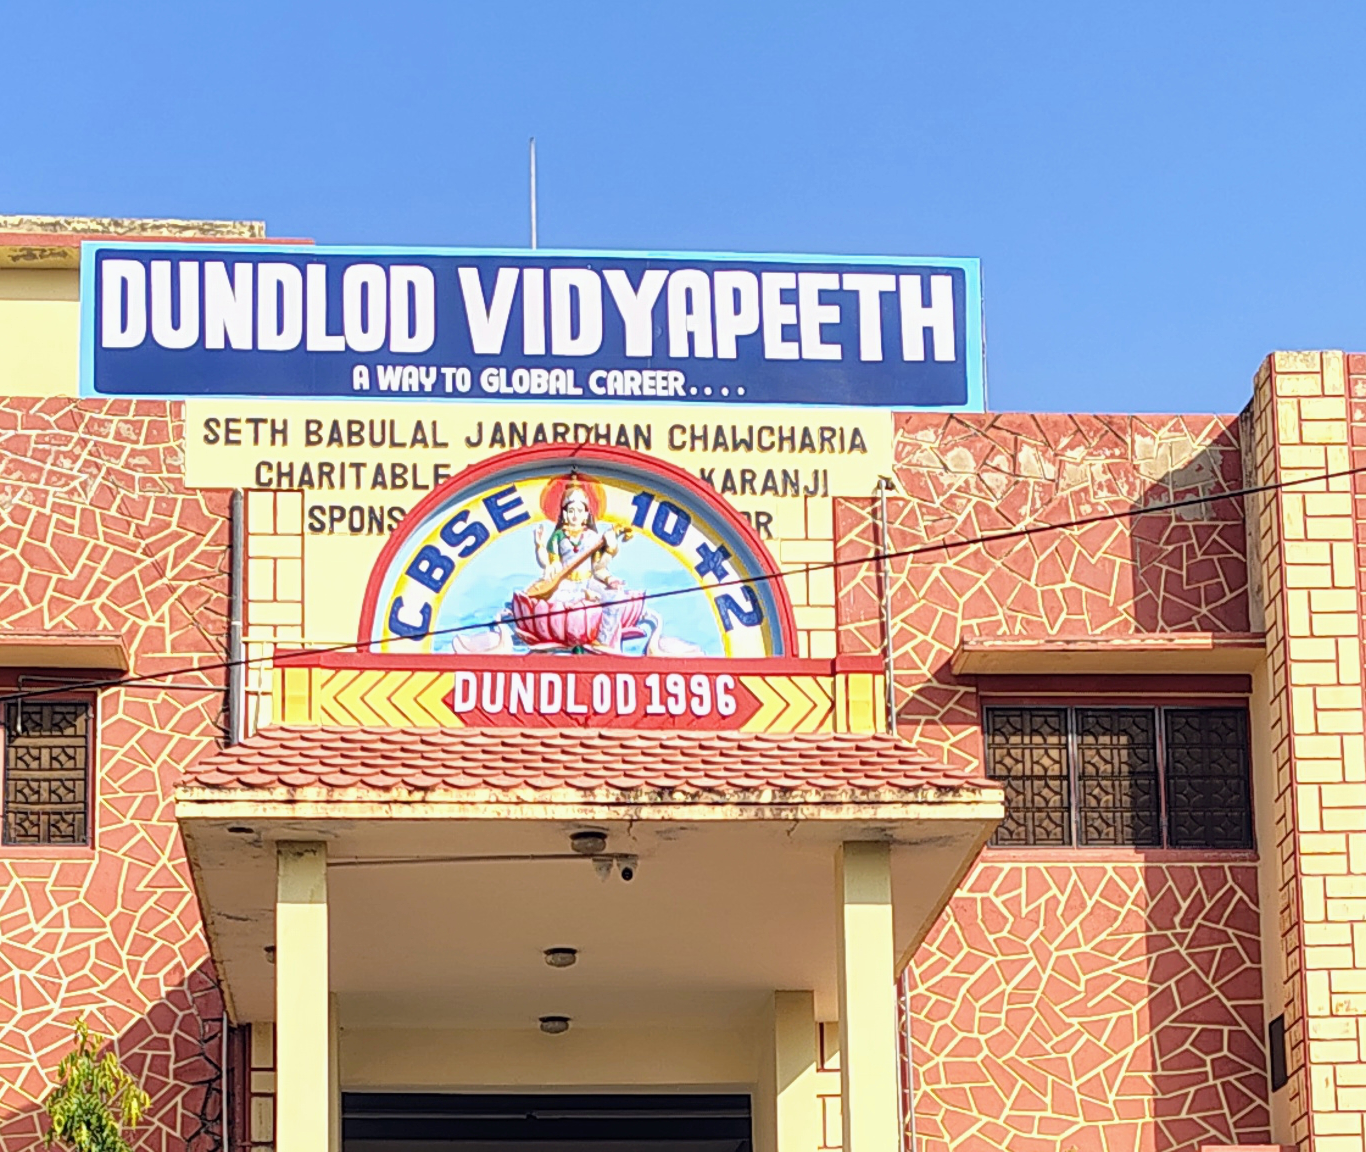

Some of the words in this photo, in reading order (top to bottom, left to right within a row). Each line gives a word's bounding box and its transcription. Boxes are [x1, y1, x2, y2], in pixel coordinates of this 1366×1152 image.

[102, 258, 436, 353] DUNDLOD
[457, 267, 956, 362] VIDYAPEETH
[352, 365, 370, 391] A
[377, 366, 436, 393] WAY
[440, 367, 472, 393] TO
[480, 367, 583, 396] GLOBAL
[203, 417, 289, 447] SETH
[304, 419, 449, 448] BABULAL
[465, 421, 652, 451] JANARDHAN
[667, 424, 868, 455] CHAWCHARIA
[255, 460, 452, 491] CHARITABLE
[388, 484, 532, 642] CBSE
[631, 489, 764, 633] 10+2
[453, 671, 636, 716] DUNDLOD
[645, 673, 737, 716] 1996
